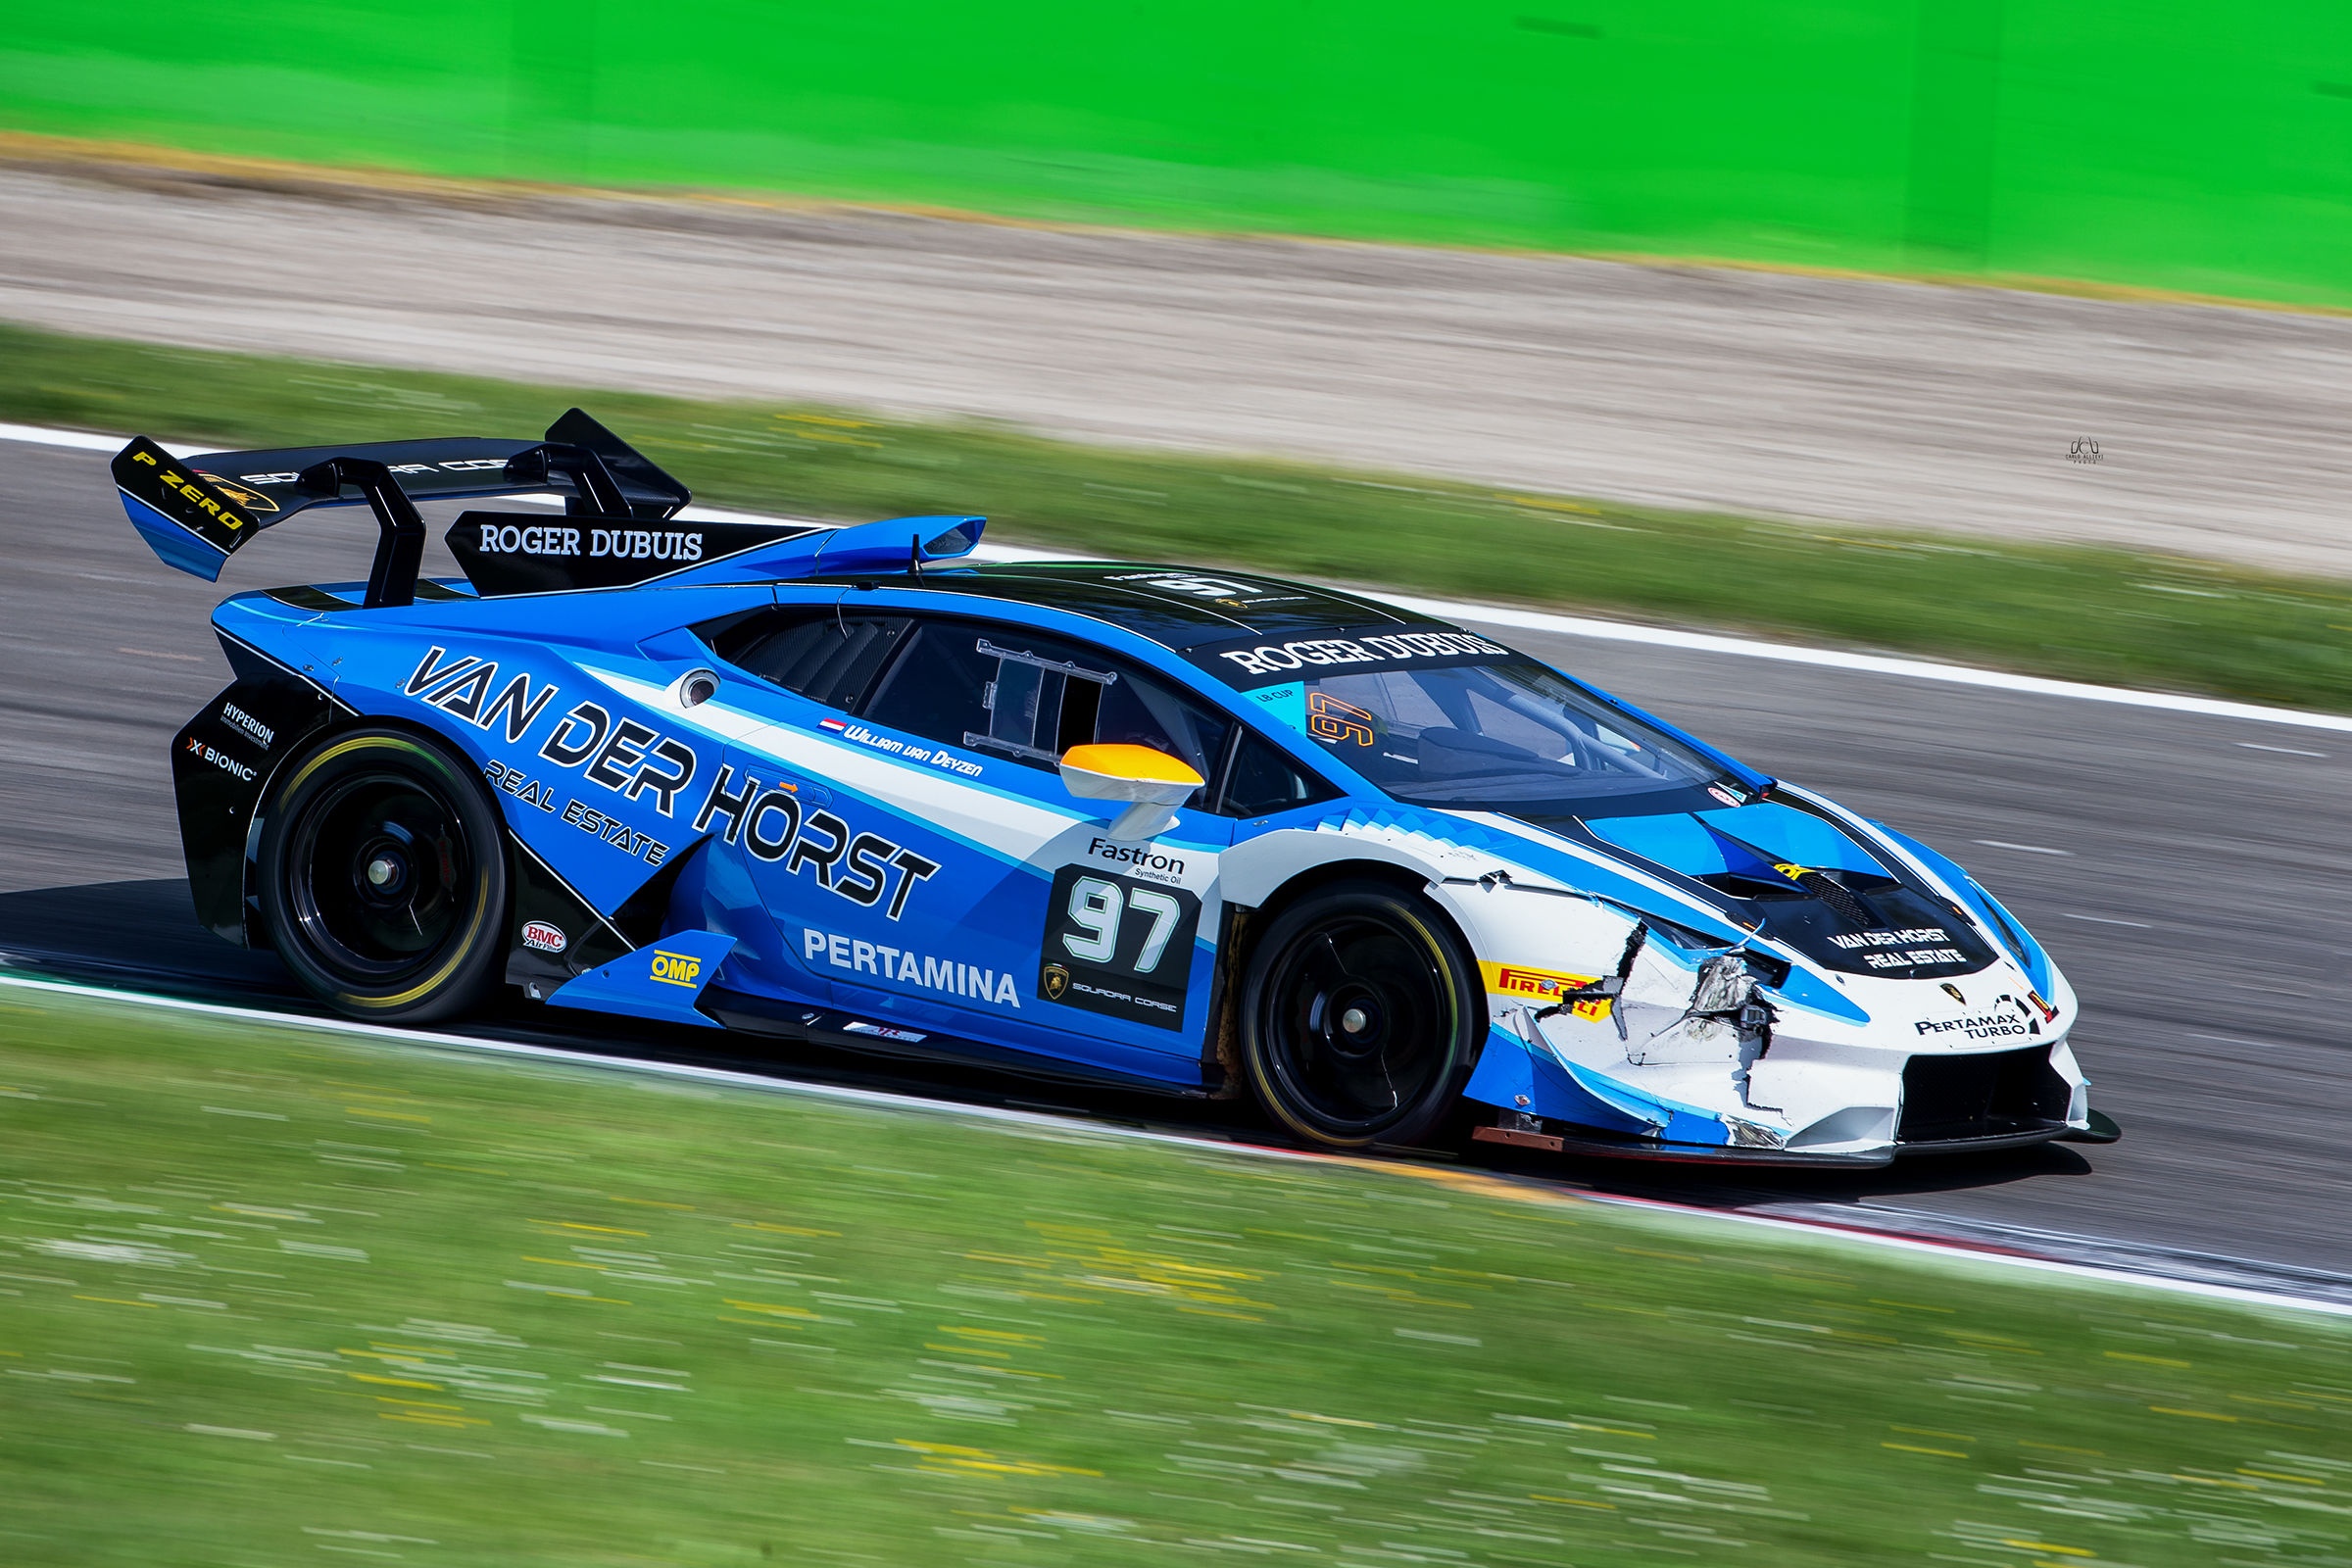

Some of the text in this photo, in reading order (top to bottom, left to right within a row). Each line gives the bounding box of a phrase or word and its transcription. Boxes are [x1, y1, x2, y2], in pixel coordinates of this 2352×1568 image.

[132, 451, 244, 530] P ZERO
[479, 524, 703, 561] ROGER DUBUIS
[1219, 632, 1510, 675] ROGER DUBUIS
[1255, 689, 1294, 703] LB CUP
[223, 702, 274, 744] HYPERION
[1309, 692, 1374, 747] 97
[403, 644, 943, 922] VAN DER HORST
[483, 759, 670, 867] REAL ESTATE
[1088, 837, 1186, 875] Fastron
[1134, 867, 1182, 885] Synthetic Oil
[526, 925, 564, 948] BMC
[1062, 875, 1181, 973] 97
[1827, 928, 1951, 950] VAN DER HORST
[651, 956, 700, 982] OMP
[804, 928, 1021, 1008] PERTAMINA
[1863, 948, 1968, 969] REAL ESTATE
[1072, 982, 1177, 1013] SQUADRA CORSE
[1914, 1013, 2021, 1036] PERTAMAX
[1964, 1024, 2027, 1040] TURBO
